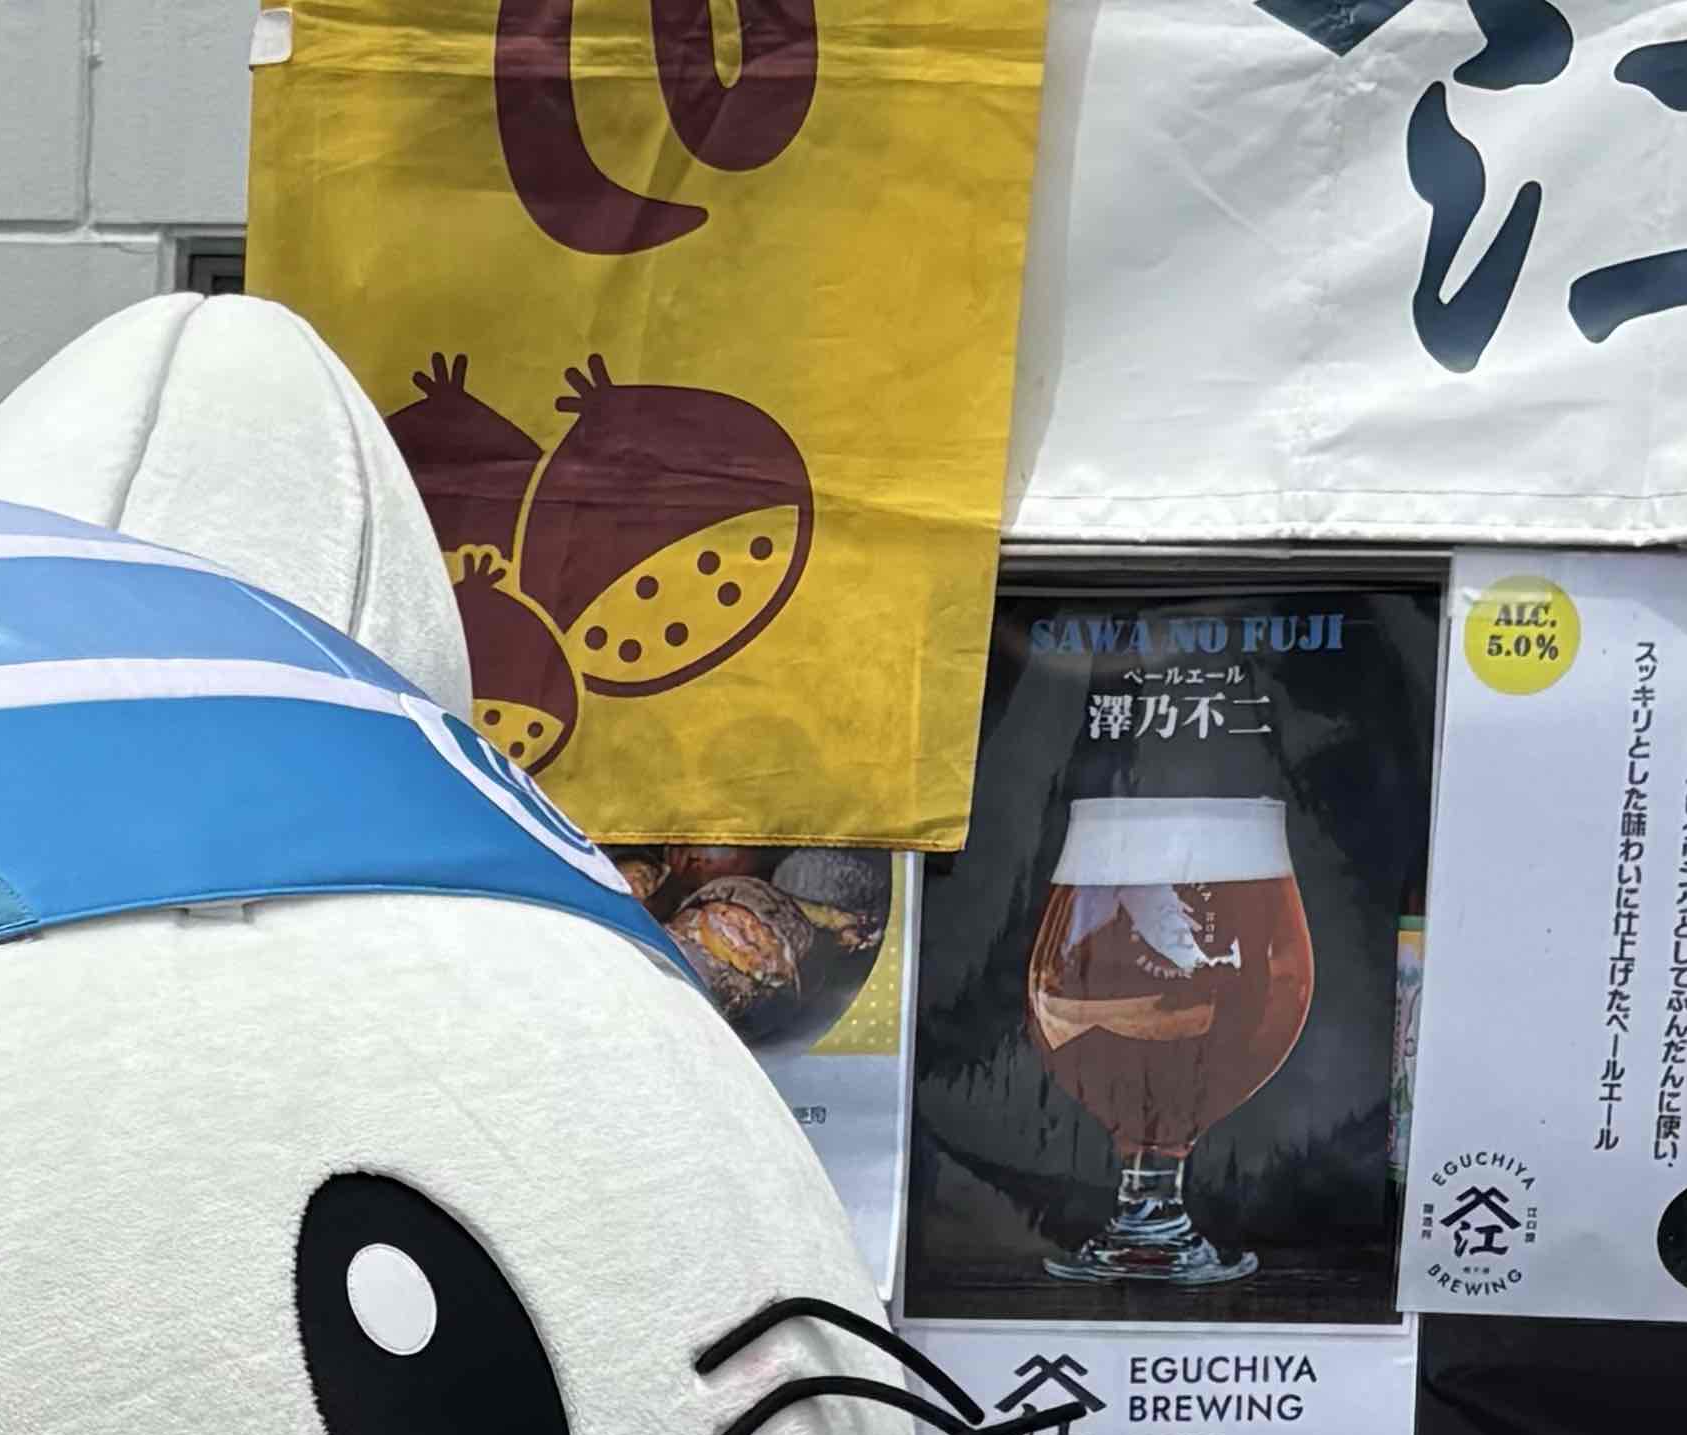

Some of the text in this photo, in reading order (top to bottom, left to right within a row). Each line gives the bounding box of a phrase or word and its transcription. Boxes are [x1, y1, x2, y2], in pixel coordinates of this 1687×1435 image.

[1494, 602, 1557, 627] ALC.
[1029, 613, 1344, 655] SAWA NO FUJI
[1487, 634, 1559, 660] 5.0%
[1123, 664, 1245, 686] ペールエール
[1088, 692, 1272, 740] 澤乃不二
[1432, 1151, 1536, 1191] EGUCHIYA
[1427, 1263, 1523, 1296] BREWING
[1129, 1355, 1318, 1384] EGUCHIYA
[1129, 1394, 1305, 1422] BREWING
